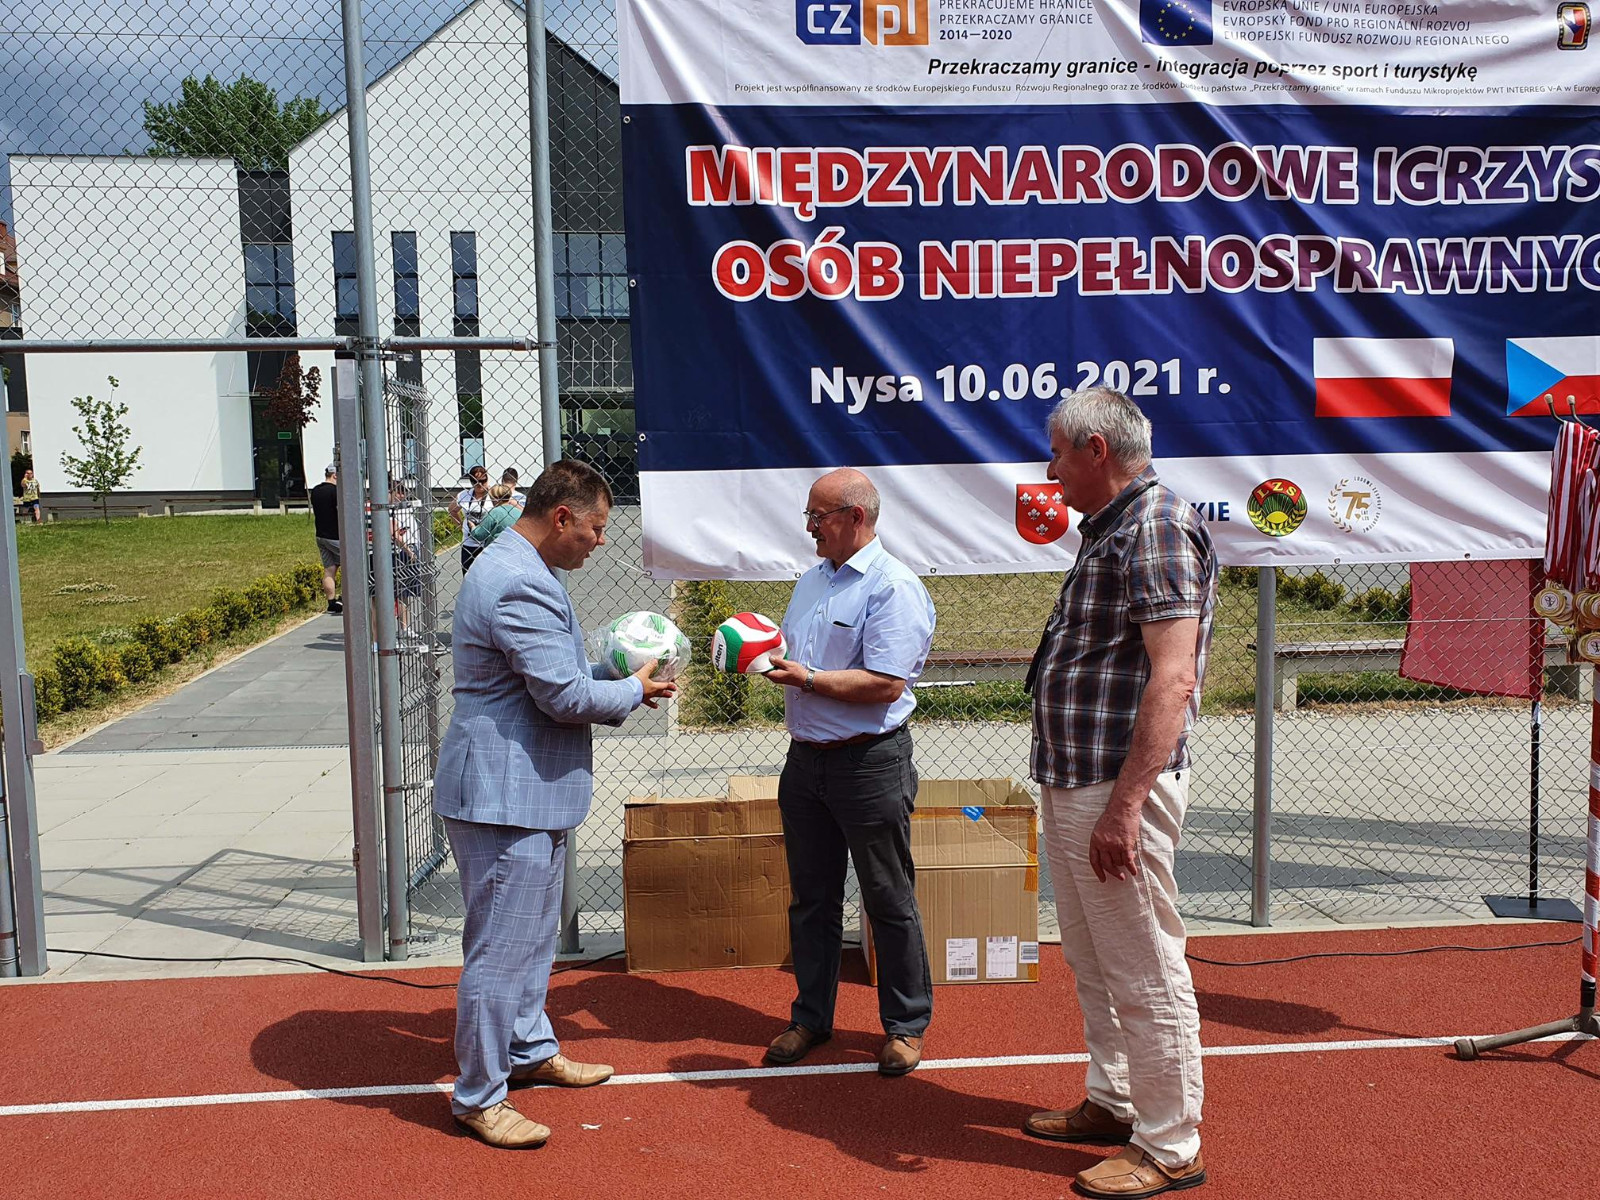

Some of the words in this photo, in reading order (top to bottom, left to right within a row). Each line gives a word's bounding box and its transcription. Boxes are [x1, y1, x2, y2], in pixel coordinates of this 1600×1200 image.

[1039, 0, 1093, 10] HRANICE
[1293, 0, 1320, 12] UNIE
[1332, 2, 1361, 14] UNIA
[1364, 3, 1438, 16] EUROPEJSKA
[939, 14, 1035, 25] PRZEKRACZAMY
[1039, 14, 1093, 25] GRANICE
[1223, 13, 1287, 27] EVROPSKÝ
[1290, 15, 1323, 27] FOND
[1327, 17, 1350, 28] PRO
[1354, 17, 1423, 31] REGIONÁLNÍ
[1427, 20, 1471, 32] ROZVOJ
[1224, 30, 1295, 42] EUROPEJSKI
[1299, 32, 1353, 44] FUNDUSZ
[1356, 33, 1412, 46] ROZWOJU
[1416, 35, 1510, 46] REGIONALNEGO
[928, 58, 1062, 78] Przekraczamy
[1066, 57, 1138, 78] granice
[1156, 56, 1249, 79] integracja
[1253, 60, 1327, 79] poprzez
[1331, 63, 1379, 80] sport
[1383, 63, 1389, 78] i
[1394, 62, 1478, 82] turystykę
[734, 83, 765, 93] Projekt
[766, 83, 782, 93] jest
[784, 82, 861, 94] współfinansowany
[863, 84, 873, 92] ze
[875, 82, 911, 92] środków
[913, 83, 970, 94] Europejskiego
[972, 83, 1011, 92] Funduszu
[1015, 83, 1051, 93] Rozwoju
[1052, 83, 1108, 93] Regionalnego
[1130, 83, 1140, 91] ze
[1141, 81, 1178, 90] środków
[1211, 83, 1247, 93] państwa
[1355, 85, 1384, 94] ramach
[1385, 86, 1422, 95] Funduszu
[1423, 86, 1485, 96] Mikroprojektów
[1486, 86, 1504, 94] PWT
[1506, 85, 1546, 94] INTERREG
[685, 141, 1359, 222] MIĘDZYNARODOWE
[1373, 144, 1600, 206] IGRZYS
[712, 225, 904, 303] OSÓB
[809, 366, 923, 415] Nysa
[935, 357, 1181, 403] 10.06.2021
[1198, 367, 1231, 395] r.
[1256, 481, 1298, 499] LZS
[1342, 491, 1371, 520] 75
